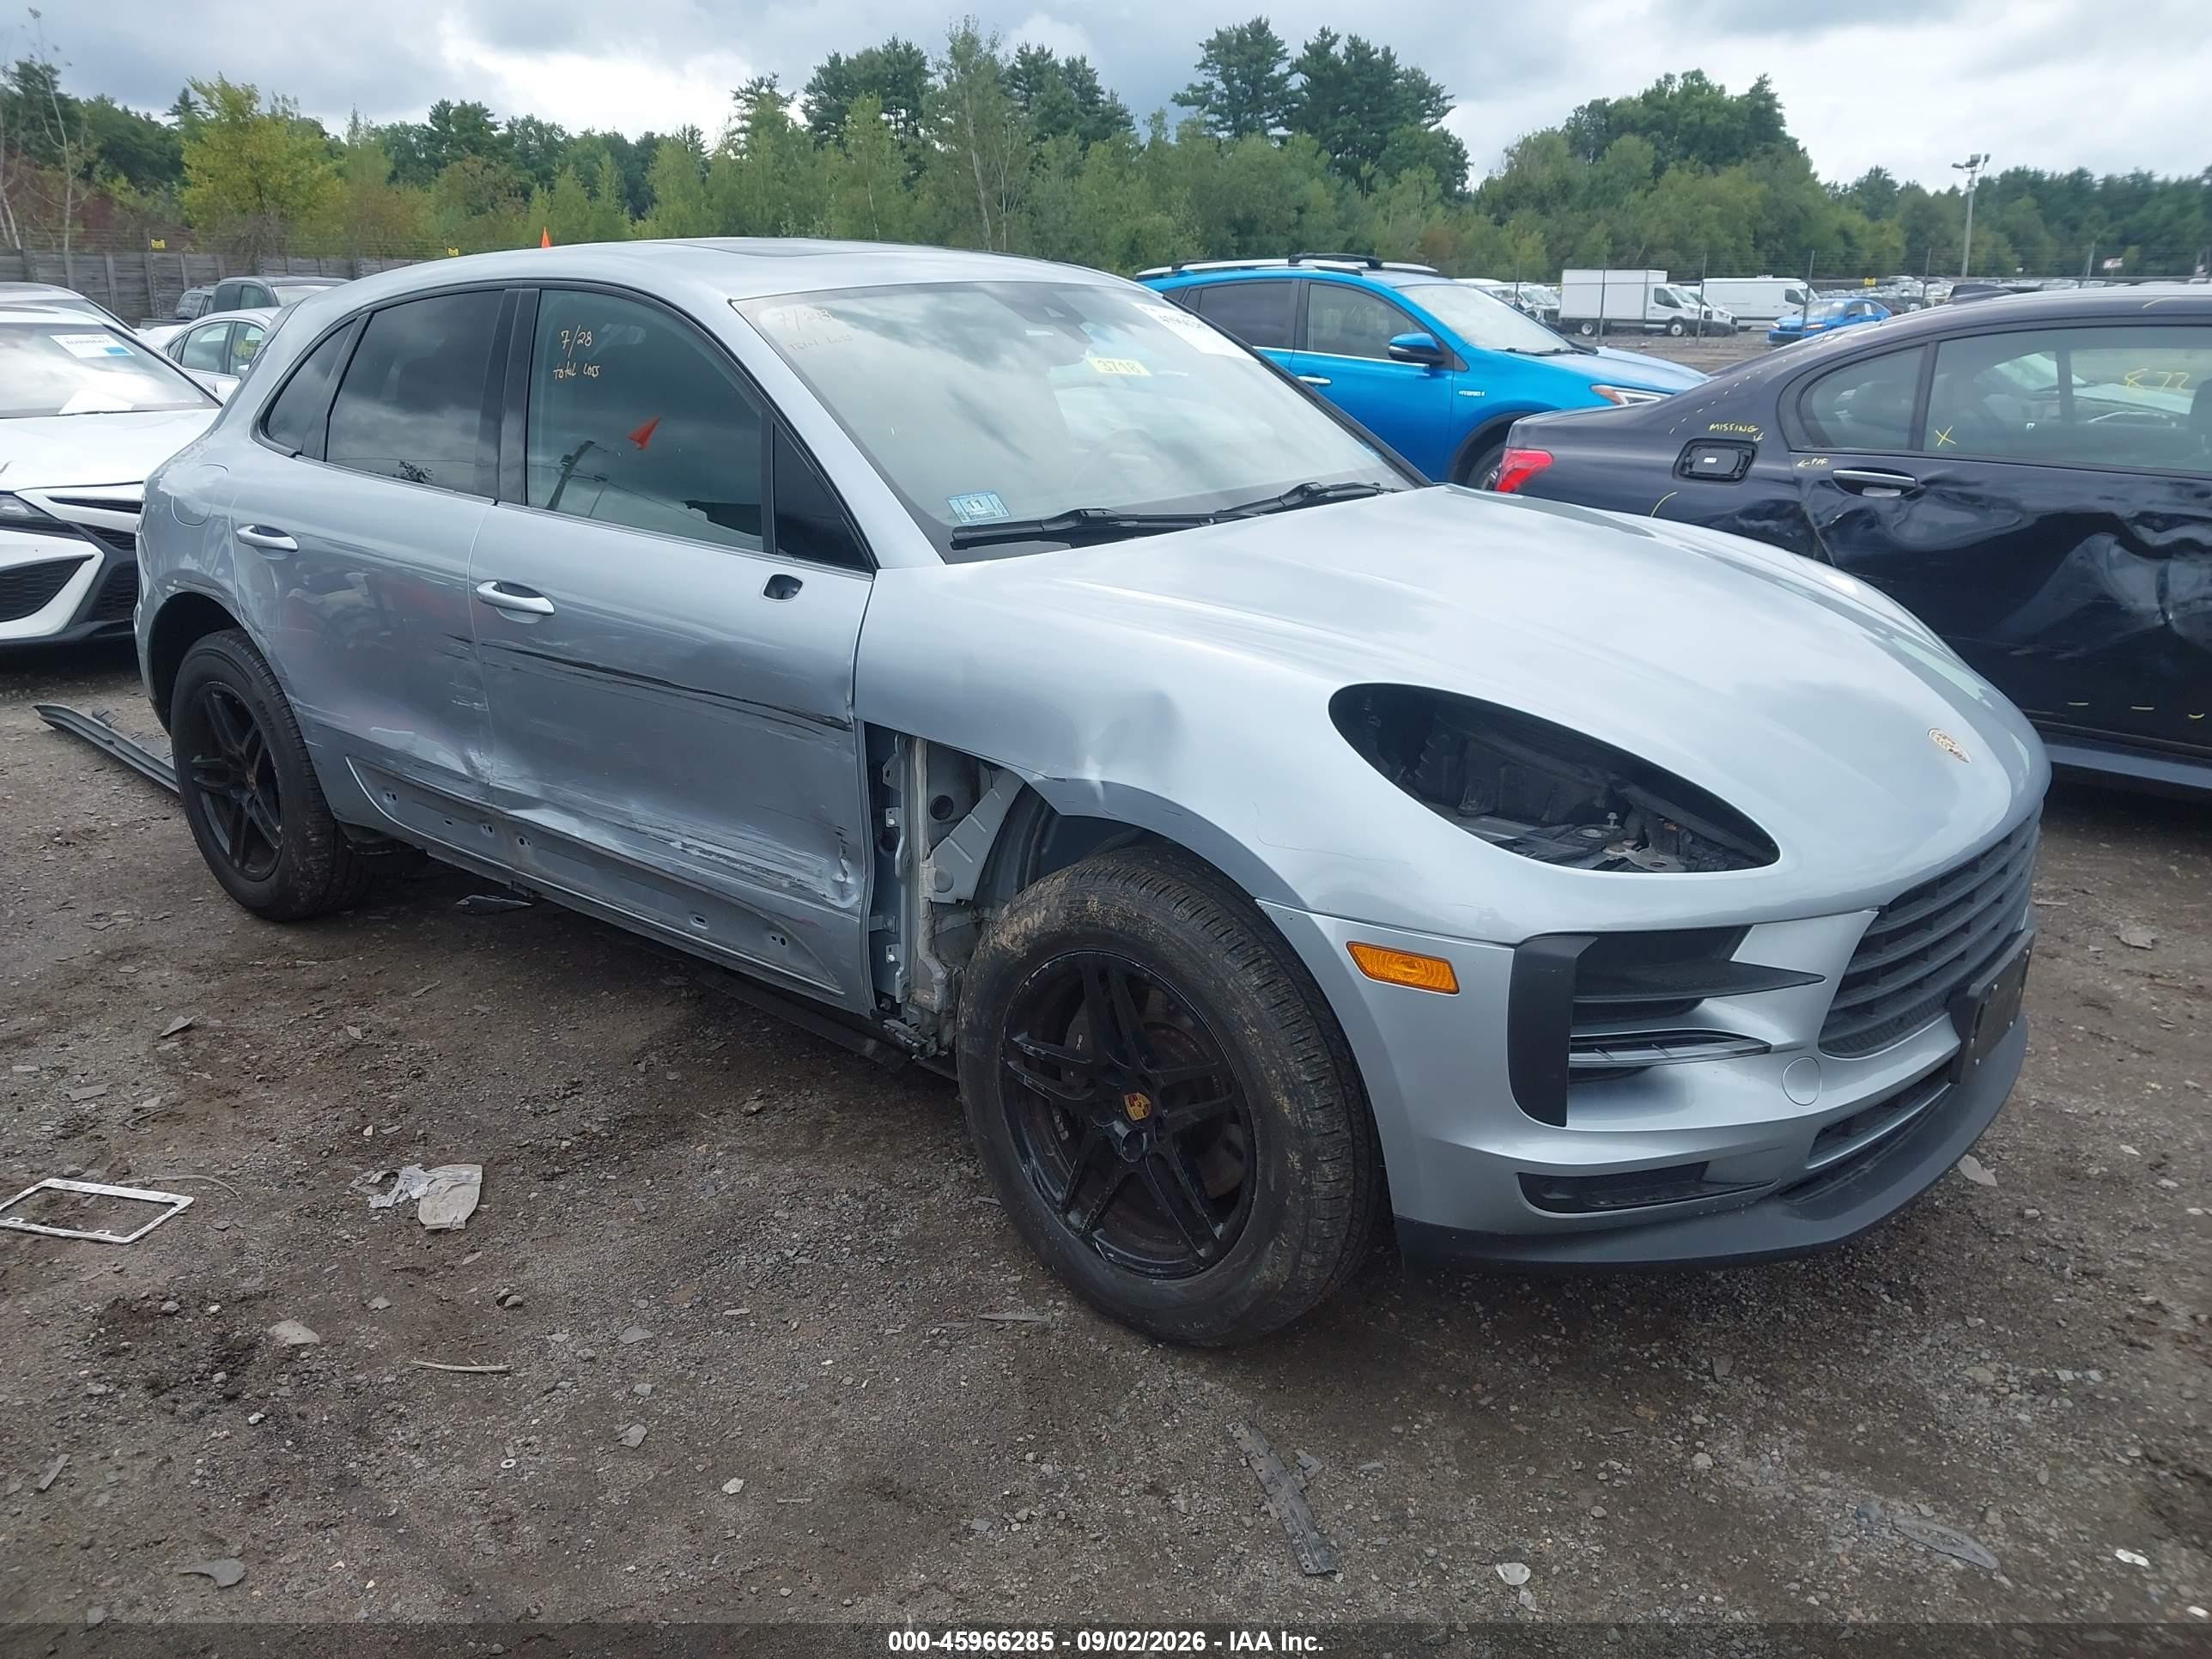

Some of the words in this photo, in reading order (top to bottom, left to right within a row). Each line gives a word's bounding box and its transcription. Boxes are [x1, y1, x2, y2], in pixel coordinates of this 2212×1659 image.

[559, 324, 593, 358] 7/28
[1097, 360, 1141, 374] 3718
[1708, 422, 1760, 434] MISSING
